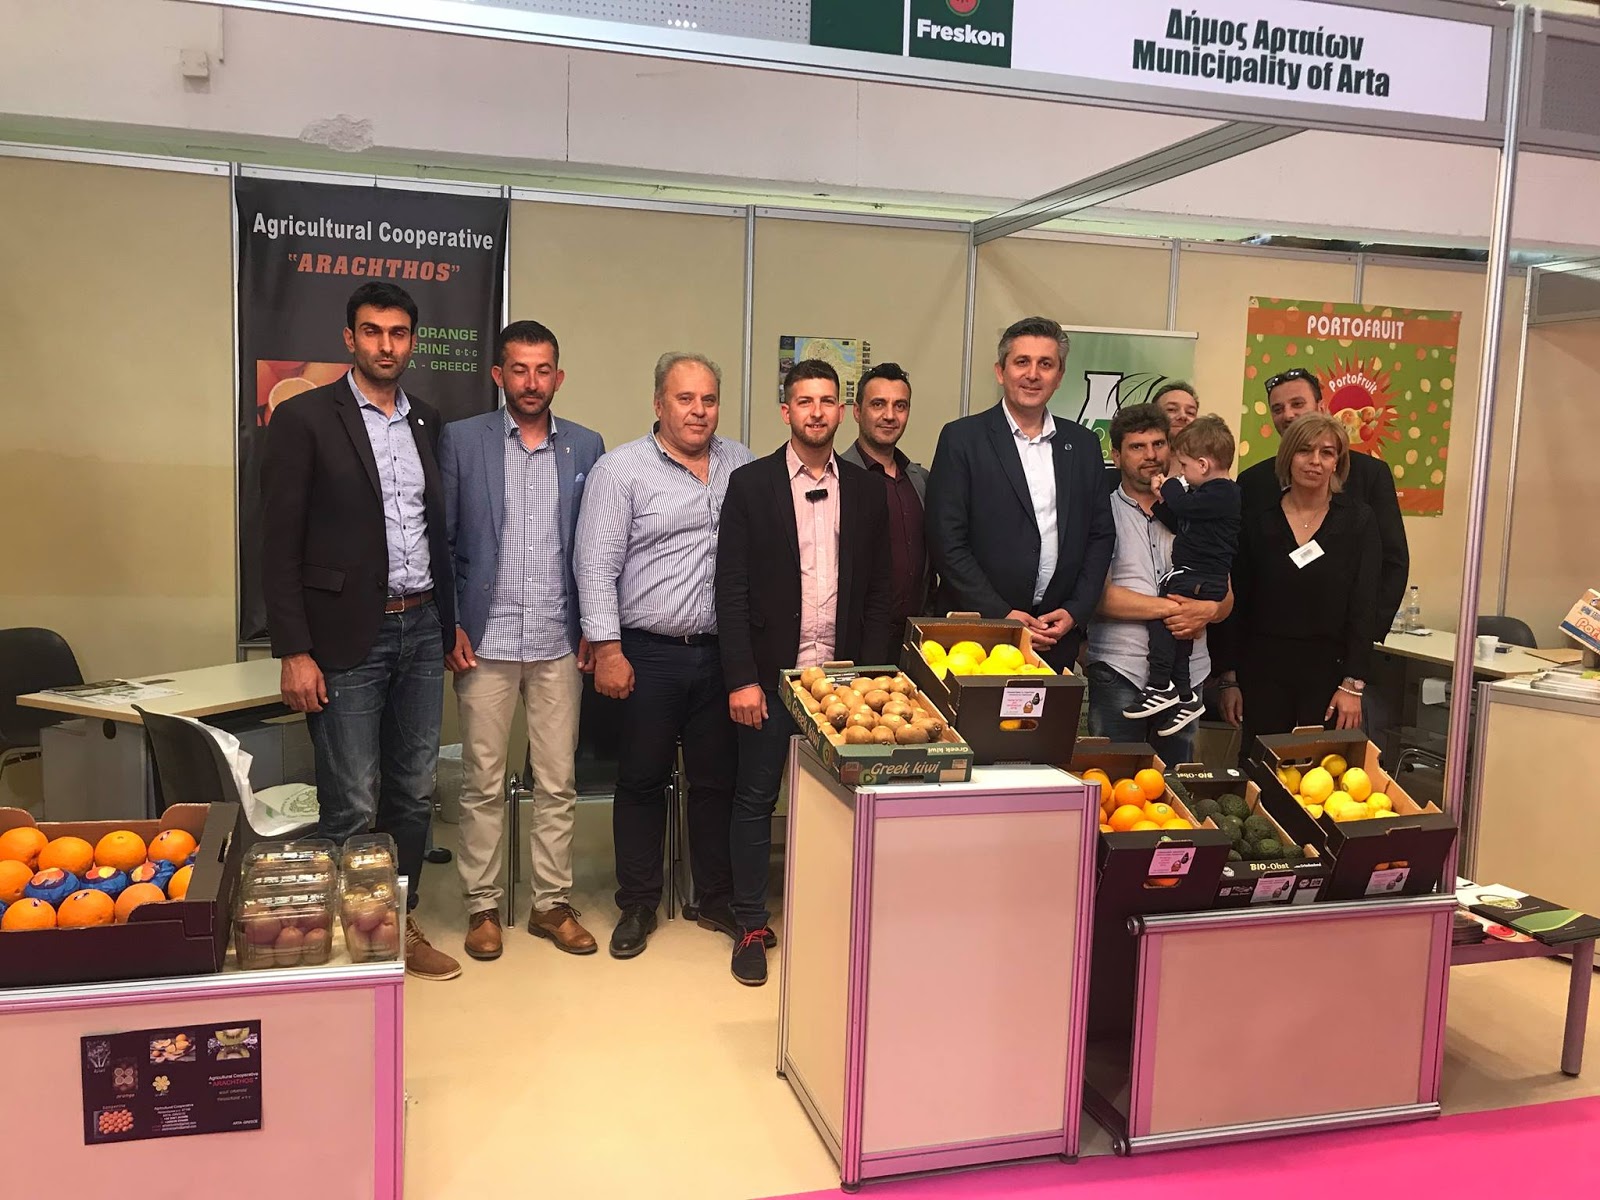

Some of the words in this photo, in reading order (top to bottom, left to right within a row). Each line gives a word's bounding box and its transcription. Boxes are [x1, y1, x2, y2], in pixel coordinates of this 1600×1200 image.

[917, 18, 1005, 47] Freskon
[1166, 8, 1248, 51] Δήμος
[1252, 19, 1364, 61] Αρταίων
[1132, 39, 1303, 90] Municipality
[1306, 62, 1333, 91] of
[1336, 63, 1390, 97] Arta
[253, 212, 372, 241] Agricultural
[379, 222, 494, 250] Cooperative
[417, 326, 478, 341] ORANGE
[1307, 315, 1404, 340] PORTOFRUIT
[412, 342, 450, 355] ERINE
[430, 360, 477, 372] GREECE
[1328, 372, 1377, 395] Portofruit
[870, 761, 911, 775] Greek
[911, 761, 941, 774] kiwi
[1249, 862, 1290, 871] BIO-Obst
